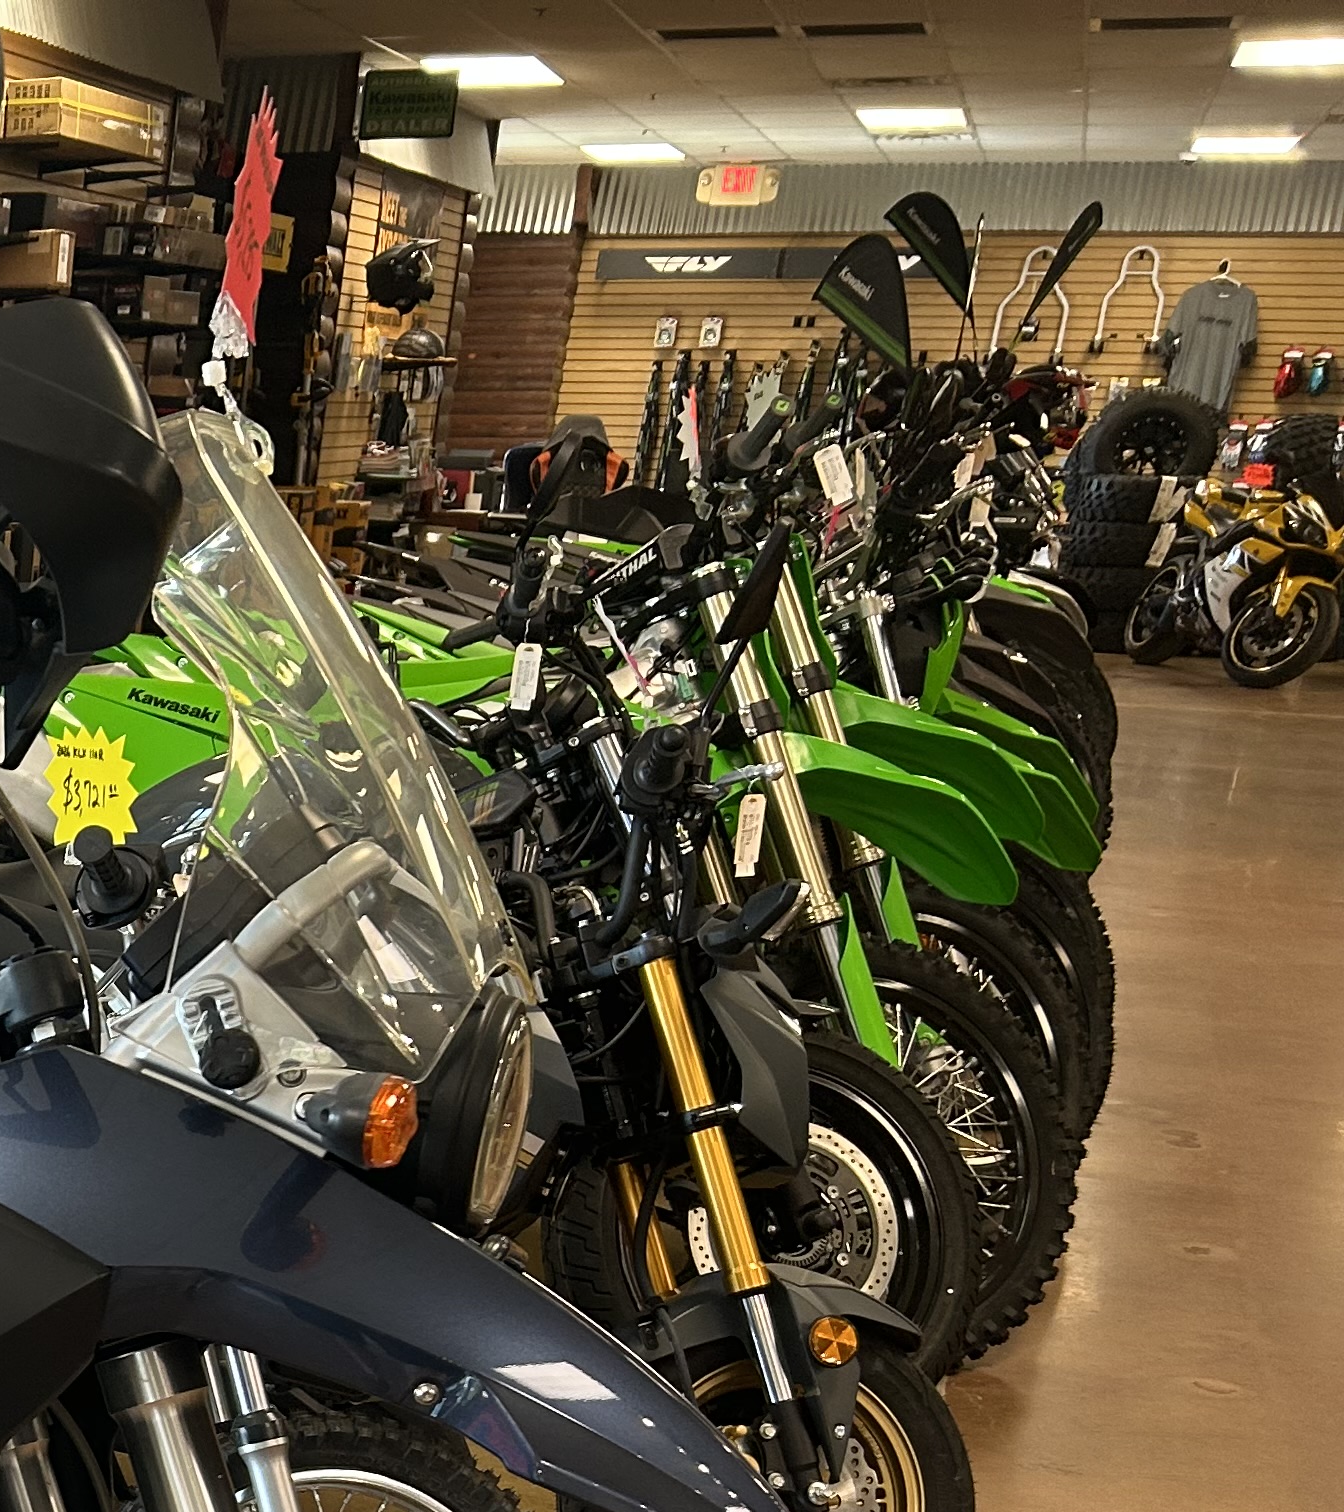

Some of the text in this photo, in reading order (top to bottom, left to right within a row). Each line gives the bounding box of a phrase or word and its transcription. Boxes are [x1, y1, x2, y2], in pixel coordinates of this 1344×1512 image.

[365, 118, 448, 132] DEALER
[645, 255, 733, 273] FLY
[838, 265, 875, 301] Kawasaki
[127, 687, 221, 724] Kawasaki
